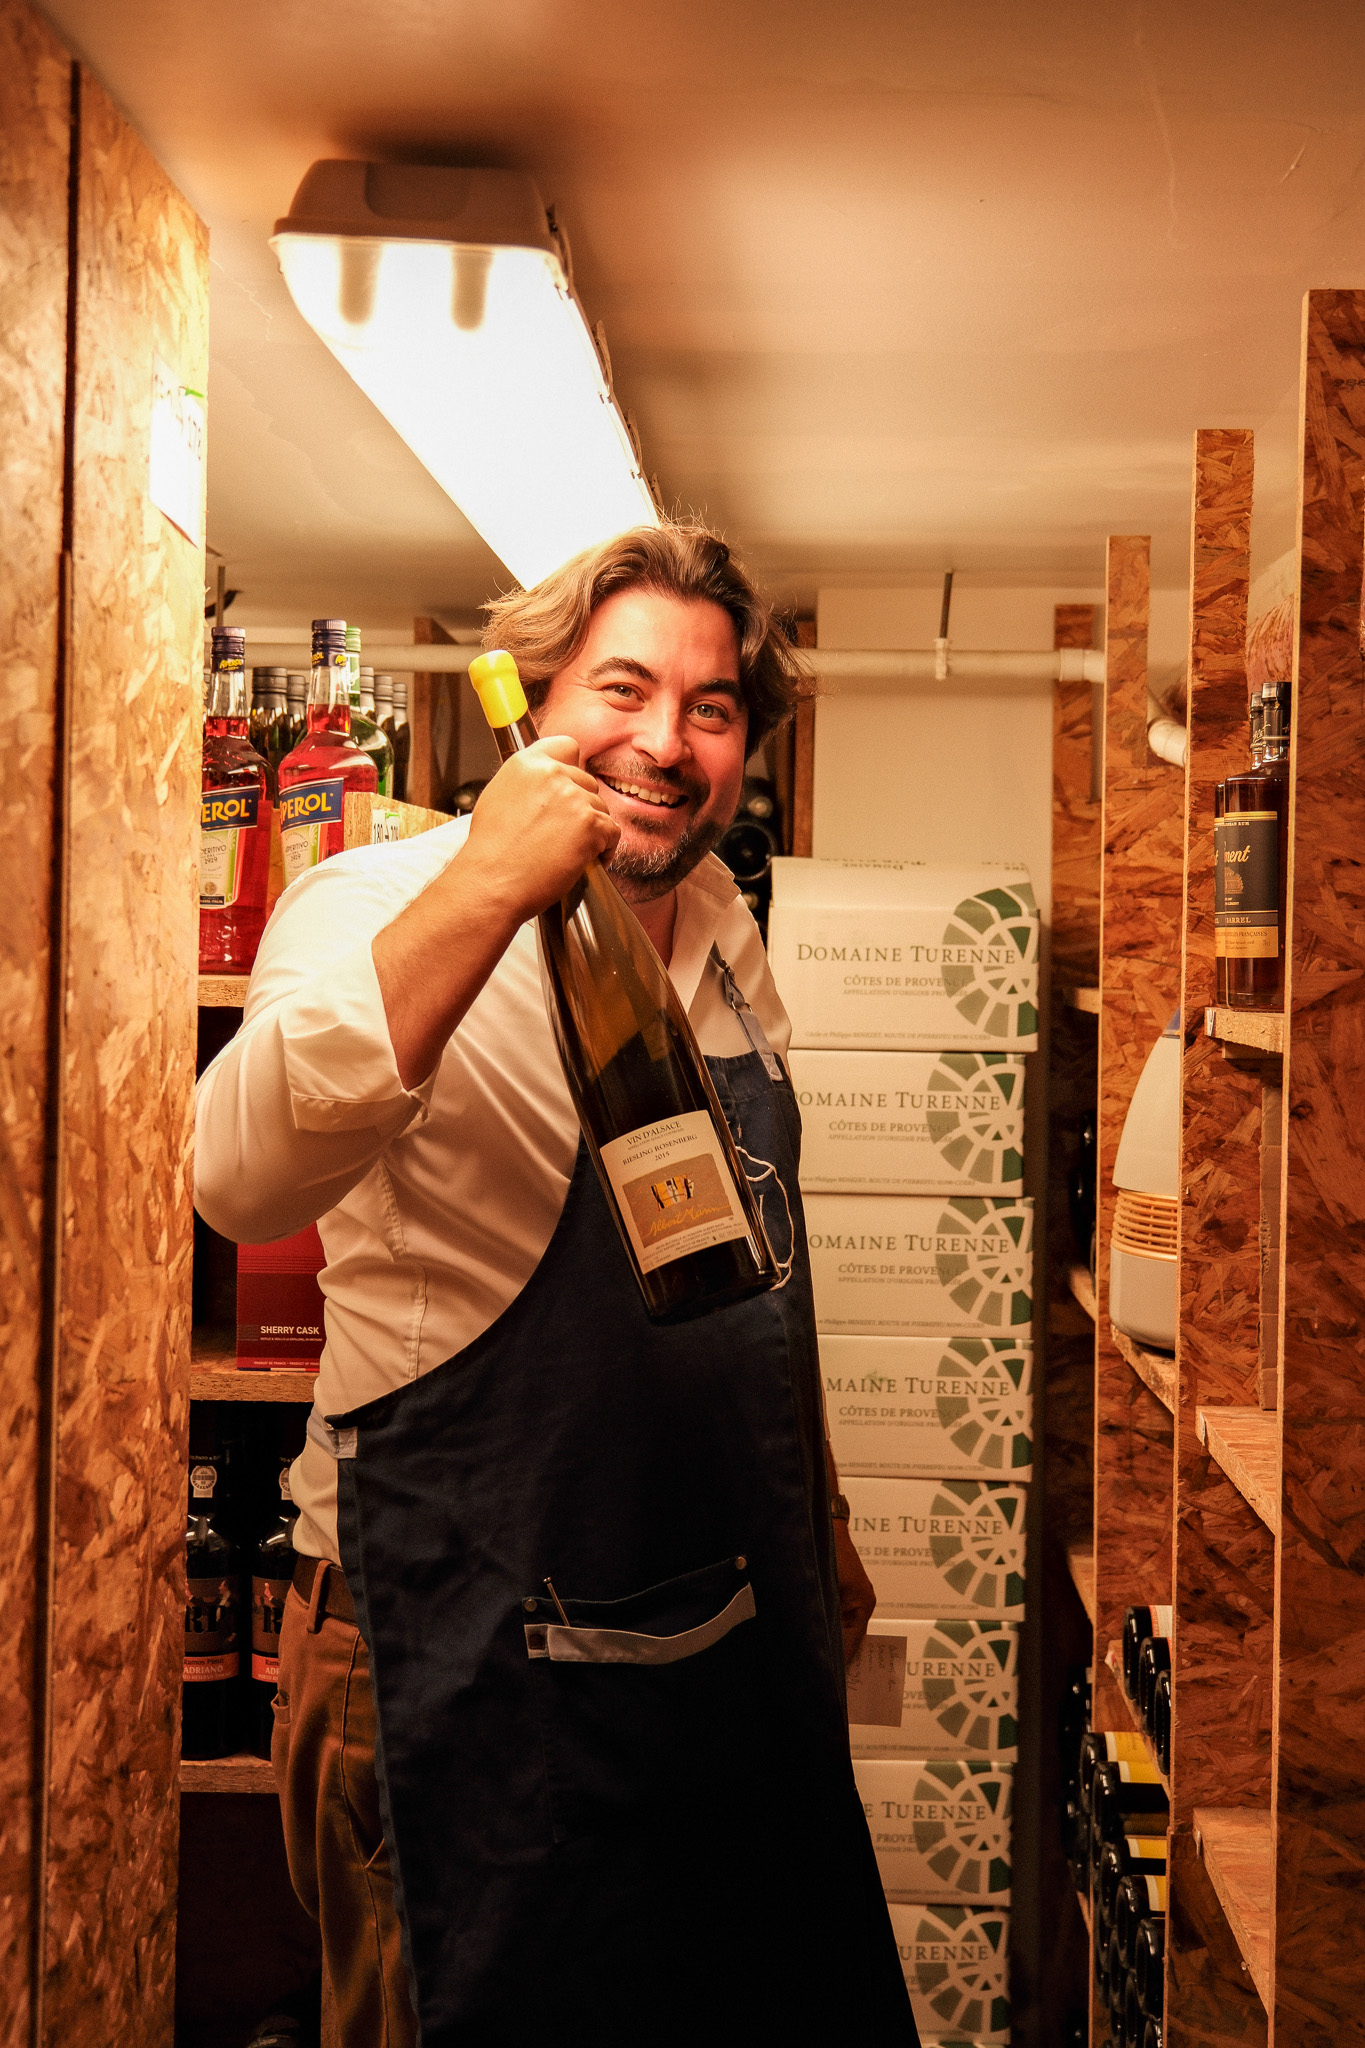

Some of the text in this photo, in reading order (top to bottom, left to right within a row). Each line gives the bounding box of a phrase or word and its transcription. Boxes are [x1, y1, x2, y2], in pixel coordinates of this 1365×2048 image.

[201, 798, 250, 823] EROL
[796, 943, 1016, 965] DOMAINE TURENNE
[843, 974, 882, 987] CÔTES
[885, 977, 901, 987] DE
[796, 1091, 1001, 1111] OMAINE TURENNE
[626, 1134, 642, 1146] VIN
[642, 1120, 682, 1140] D'ALSACE
[829, 1119, 868, 1132] CÔTES
[870, 1122, 887, 1133] DE
[622, 1146, 654, 1166] RIESLING
[654, 1133, 698, 1152] ROSENBERG
[809, 1233, 1010, 1254] OMAINE TURENNE
[838, 1263, 877, 1275] CÔTES
[879, 1265, 896, 1275] DE
[260, 1325, 320, 1336] SHERRY CASK
[826, 1376, 1011, 1396] MAINE TURENNE
[839, 1404, 877, 1418] CÔTES
[879, 1407, 896, 1418] DE
[897, 1516, 1003, 1535] TURENNE
[873, 1547, 890, 1557] DE
[183, 1665, 224, 1674] ADRIANO
[905, 1661, 997, 1678] URENNE
[881, 1800, 988, 1820] TURENNE
[899, 1945, 990, 1961] URENNE
